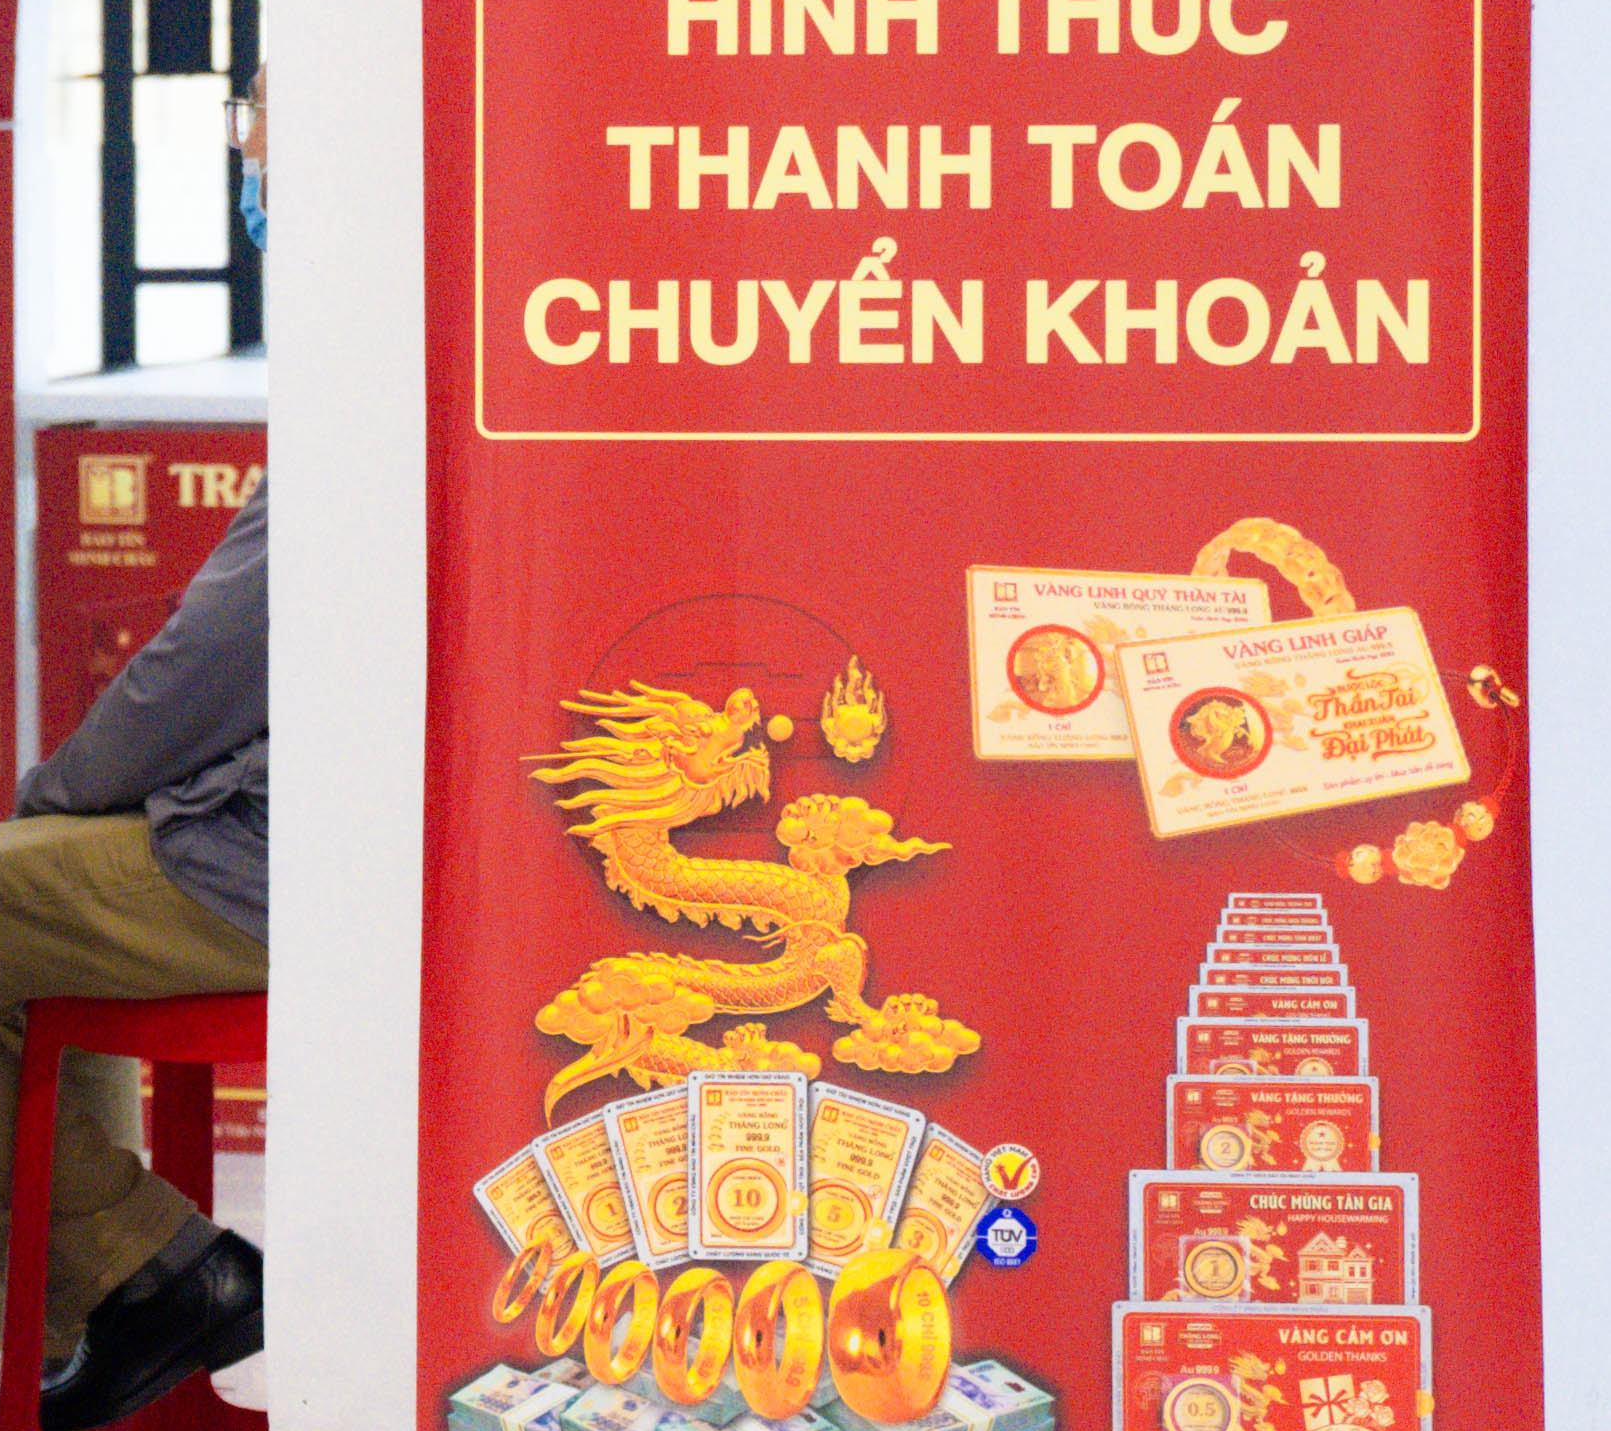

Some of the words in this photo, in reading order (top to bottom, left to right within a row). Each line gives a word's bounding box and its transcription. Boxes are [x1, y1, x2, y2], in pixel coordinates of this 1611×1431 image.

[606, 125, 992, 210] THANH
[1027, 98, 1342, 210] TOÁN
[523, 237, 985, 366] CHUYỂN
[1026, 251, 1430, 365] KHOẢN
[1224, 639, 1283, 659] VÀNG
[1289, 633, 1336, 651] LINH
[1342, 624, 1387, 643] GIÁP
[732, 1190, 761, 1206] 10
[1250, 1193, 1286, 1210] CHÚC
[1368, 1196, 1392, 1211] GIA
[1288, 1214, 1314, 1222] HAPPY
[1317, 1215, 1388, 1224] HOUSEWARMING
[1279, 1327, 1328, 1344] VÀNG
[1336, 1326, 1373, 1345] CẢM
[1298, 1351, 1343, 1361] GOLDEN
[1345, 1352, 1386, 1362] THANKS
[1188, 1404, 1215, 1417] 0.5
